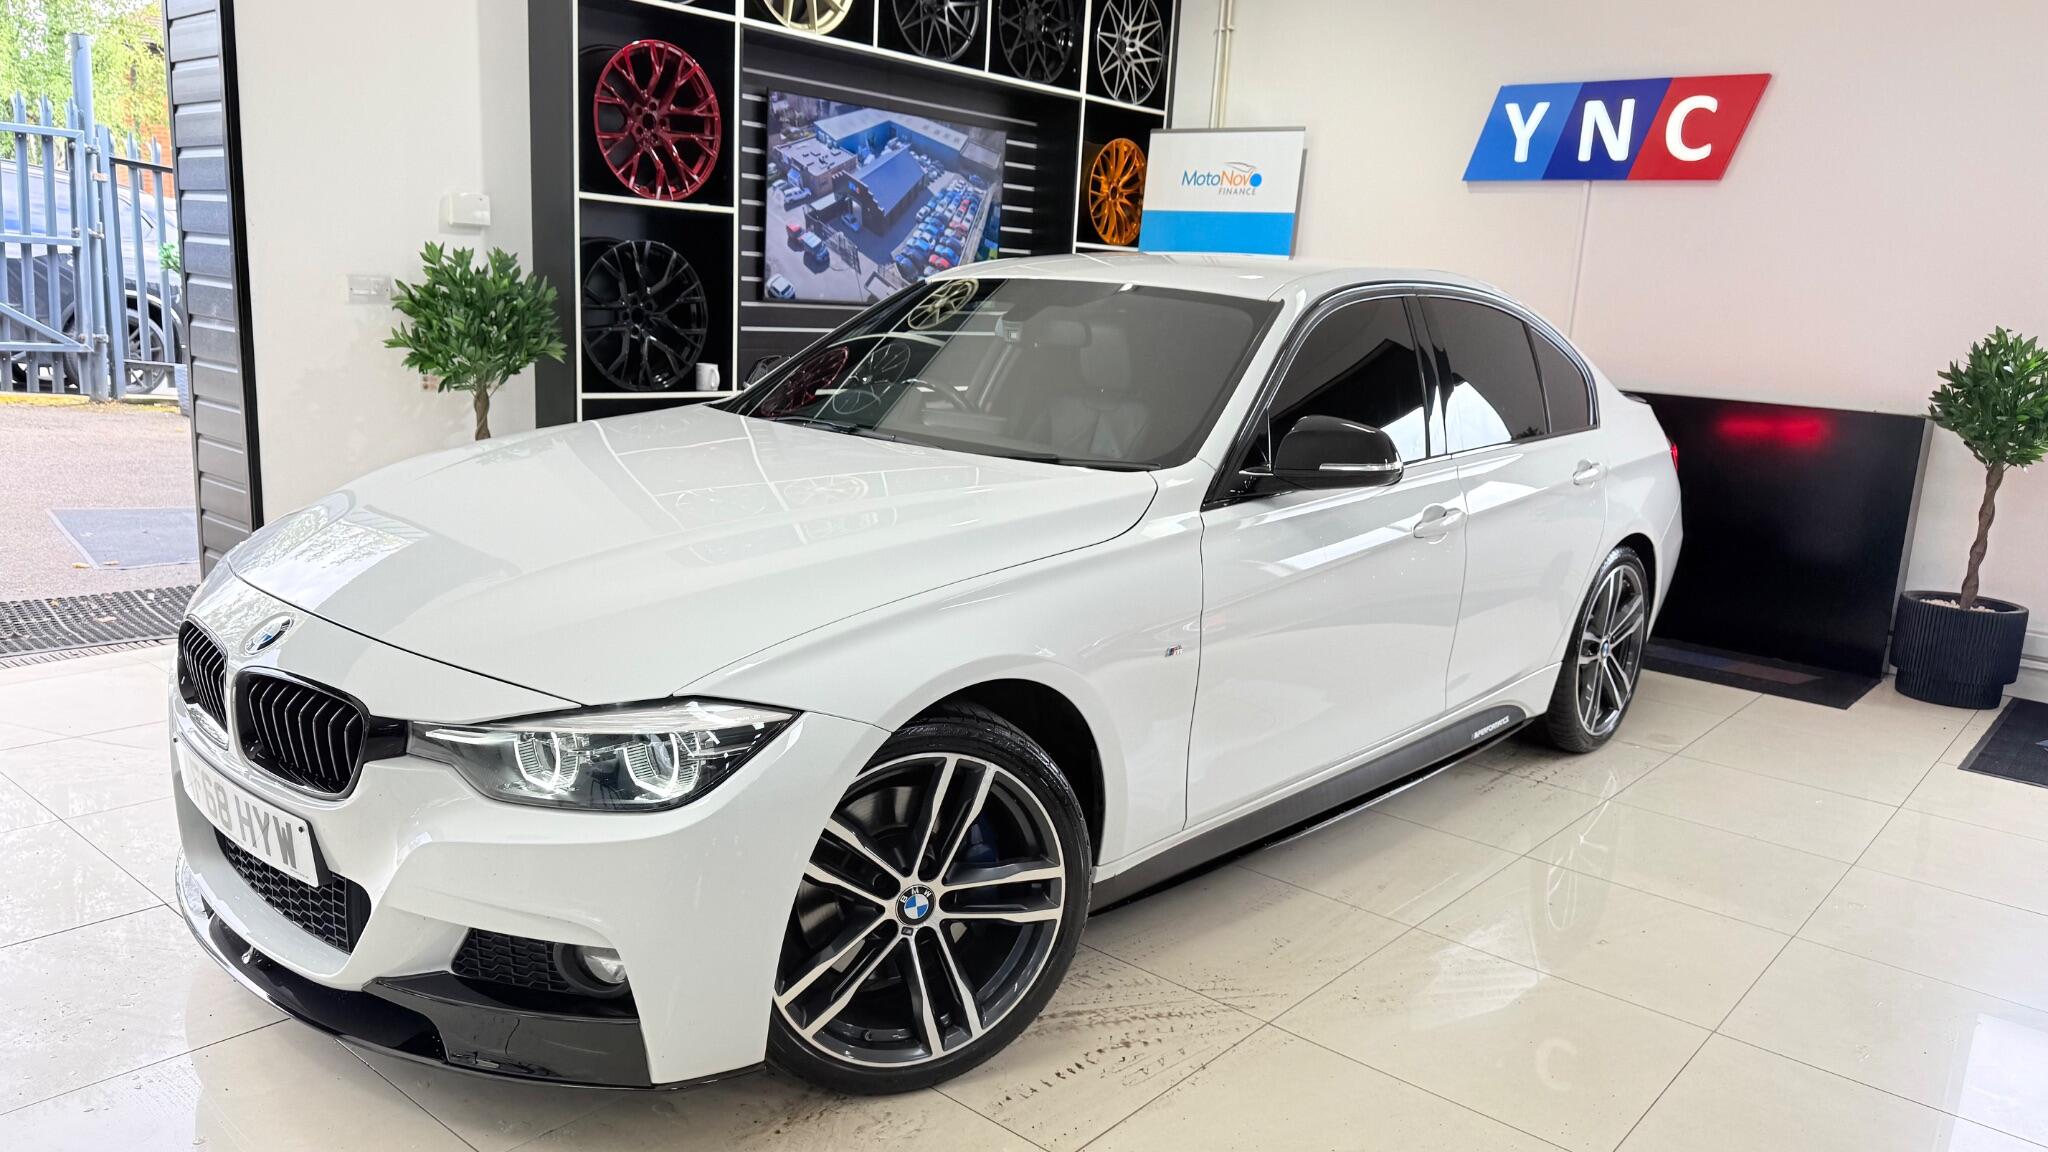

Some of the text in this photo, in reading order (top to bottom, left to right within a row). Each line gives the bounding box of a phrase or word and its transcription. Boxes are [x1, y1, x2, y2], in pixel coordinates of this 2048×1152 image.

[1504, 94, 1719, 163] YNC
[1181, 168, 1262, 188] MotoNovo
[1218, 187, 1256, 196] FINANCE
[234, 794, 298, 870] HYW
[900, 886, 932, 903] BMW
